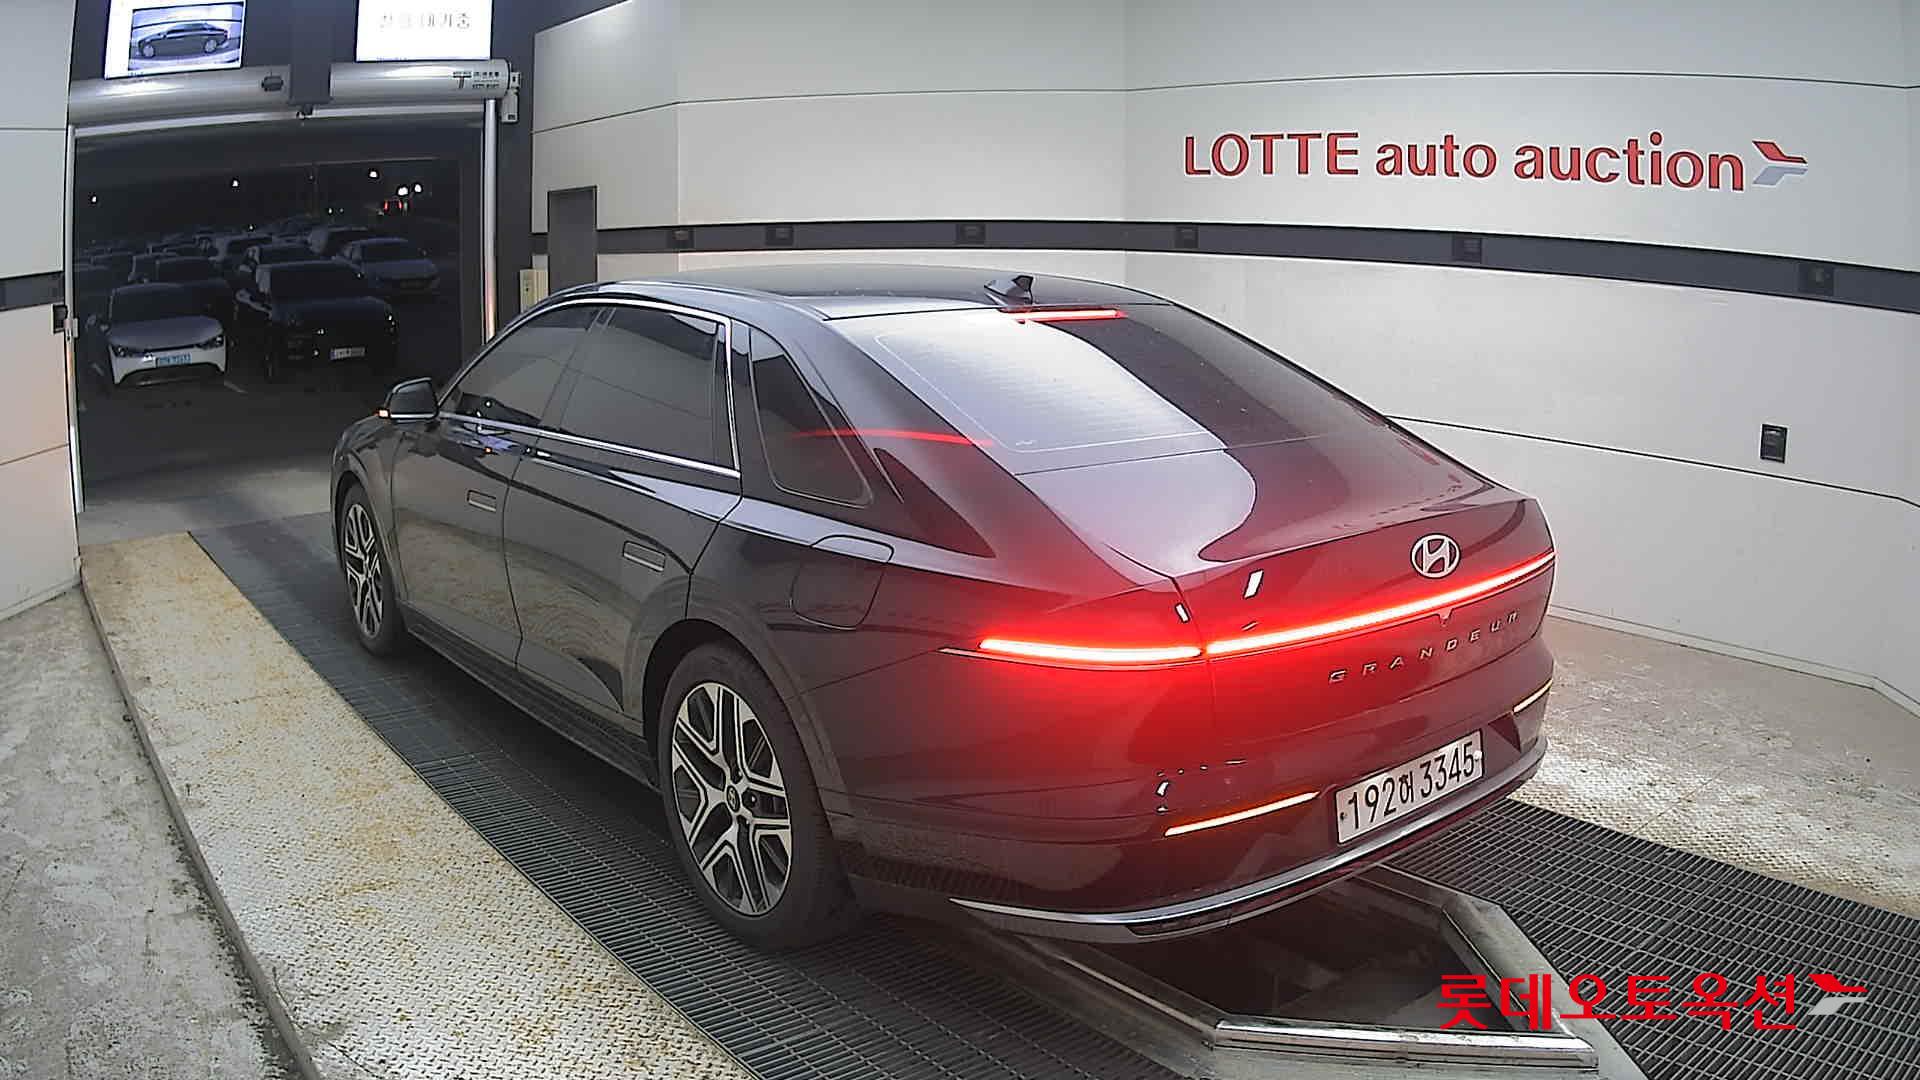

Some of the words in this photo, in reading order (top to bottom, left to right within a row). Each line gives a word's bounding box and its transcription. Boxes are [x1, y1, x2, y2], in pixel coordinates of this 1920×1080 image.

[1184, 132, 1359, 177] LOTTE
[1376, 134, 1498, 178] auto
[1513, 131, 1745, 192] auction
[1328, 610, 1520, 685] GRANDEUR
[1420, 741, 1475, 798] 3345
